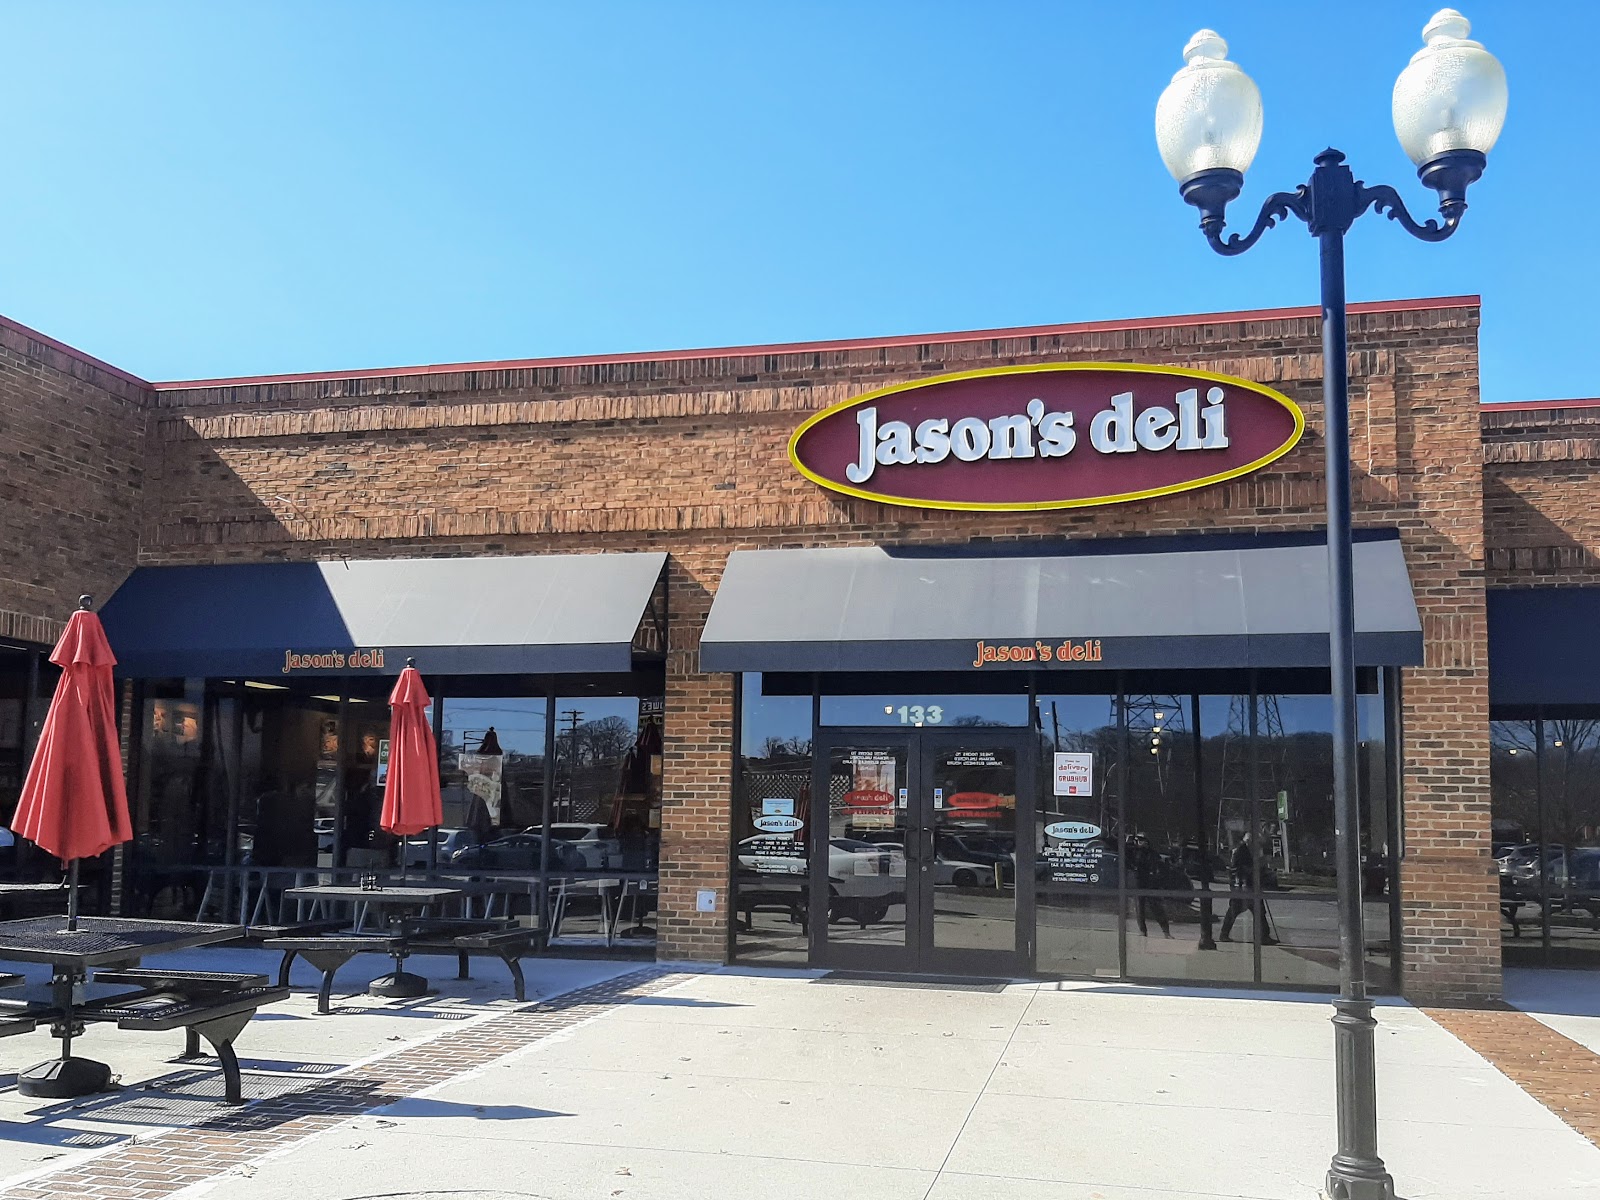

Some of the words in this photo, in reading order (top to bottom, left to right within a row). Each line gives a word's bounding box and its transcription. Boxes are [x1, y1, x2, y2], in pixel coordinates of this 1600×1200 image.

[845, 398, 1077, 484] Jason's
[1090, 386, 1229, 454] deli
[282, 649, 345, 673] Jason's
[348, 649, 385, 668] deli
[973, 640, 1052, 668] Jason's
[1056, 640, 1102, 662] deli
[897, 705, 942, 724] 133
[1058, 764, 1089, 772] delivery
[760, 820, 783, 828] Jason's
[1052, 826, 1078, 834] Jason's
